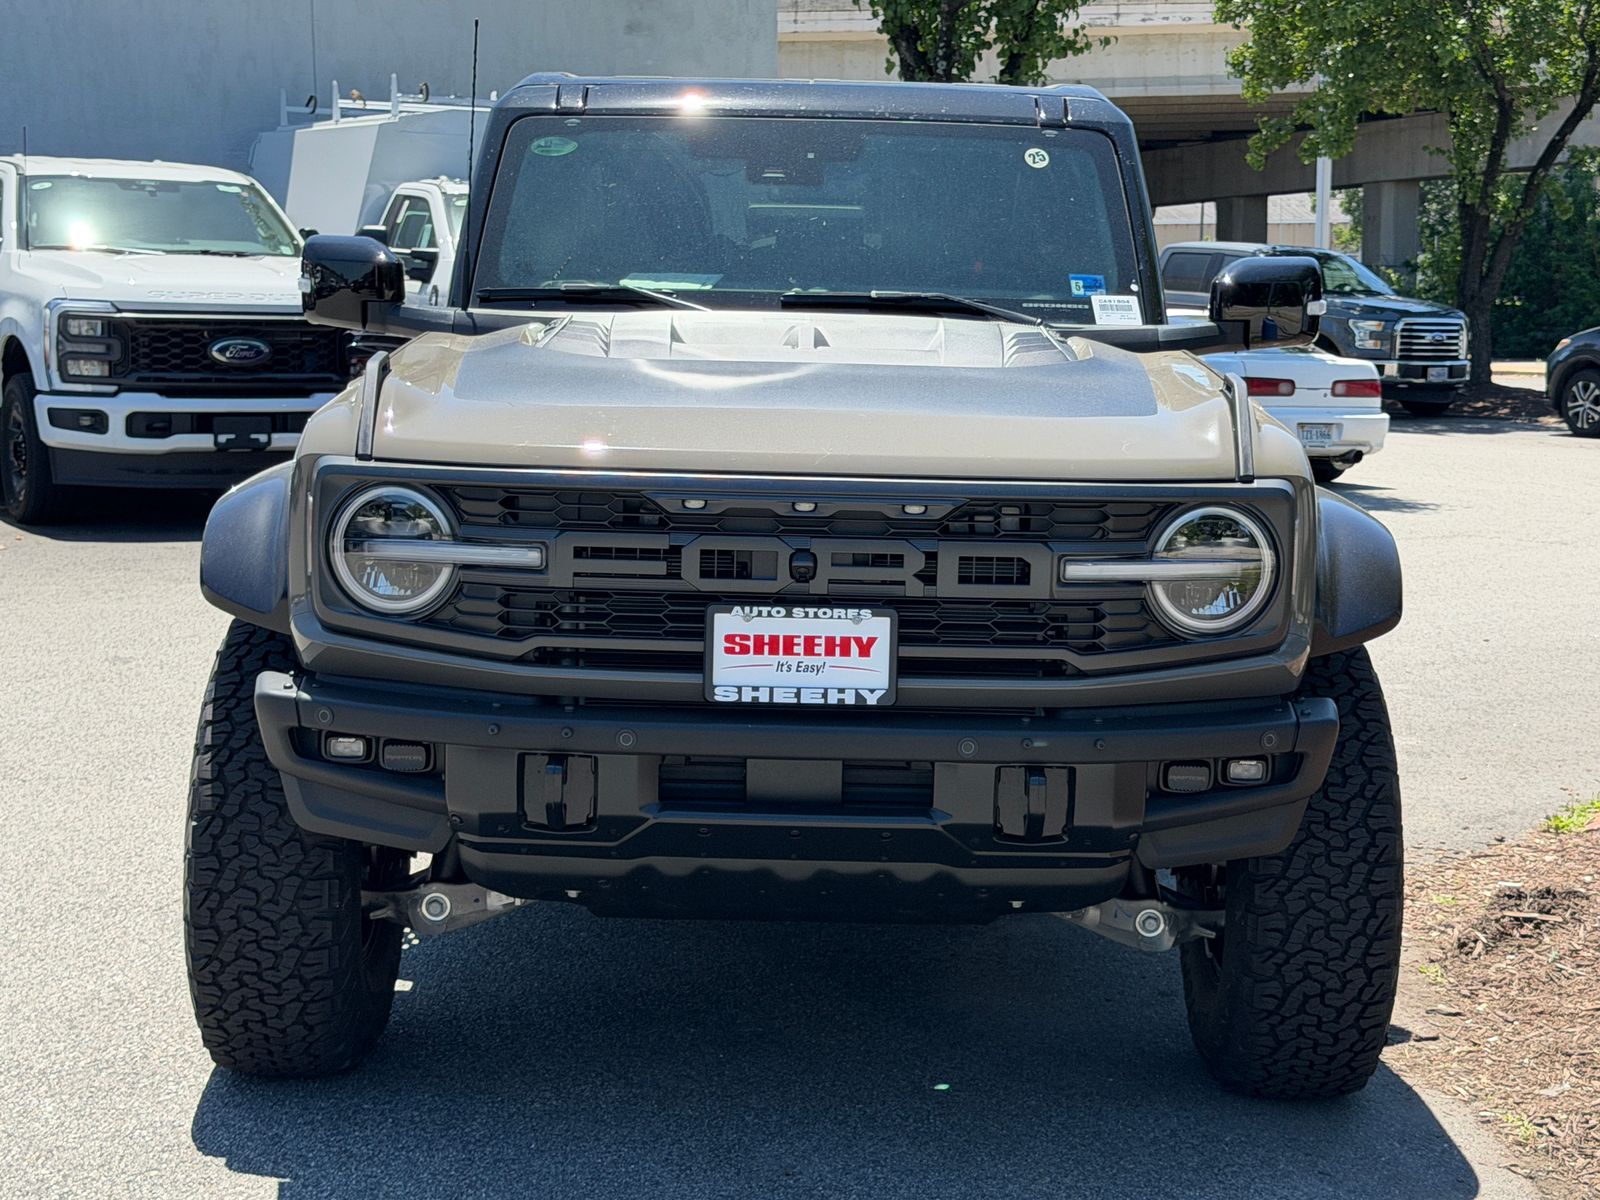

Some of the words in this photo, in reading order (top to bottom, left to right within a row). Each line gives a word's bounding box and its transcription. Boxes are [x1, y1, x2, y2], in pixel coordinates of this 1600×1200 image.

[1028, 151, 1047, 164] 25
[250, 292, 301, 301] DUT
[225, 345, 258, 358] Ford
[555, 531, 1054, 598] FORD
[730, 605, 786, 618] AUTO
[791, 607, 873, 619] STORES
[723, 633, 879, 658] SHEEHY
[775, 661, 792, 673] It's
[795, 661, 827, 676] Easy!
[713, 686, 888, 705] SHEEHY
